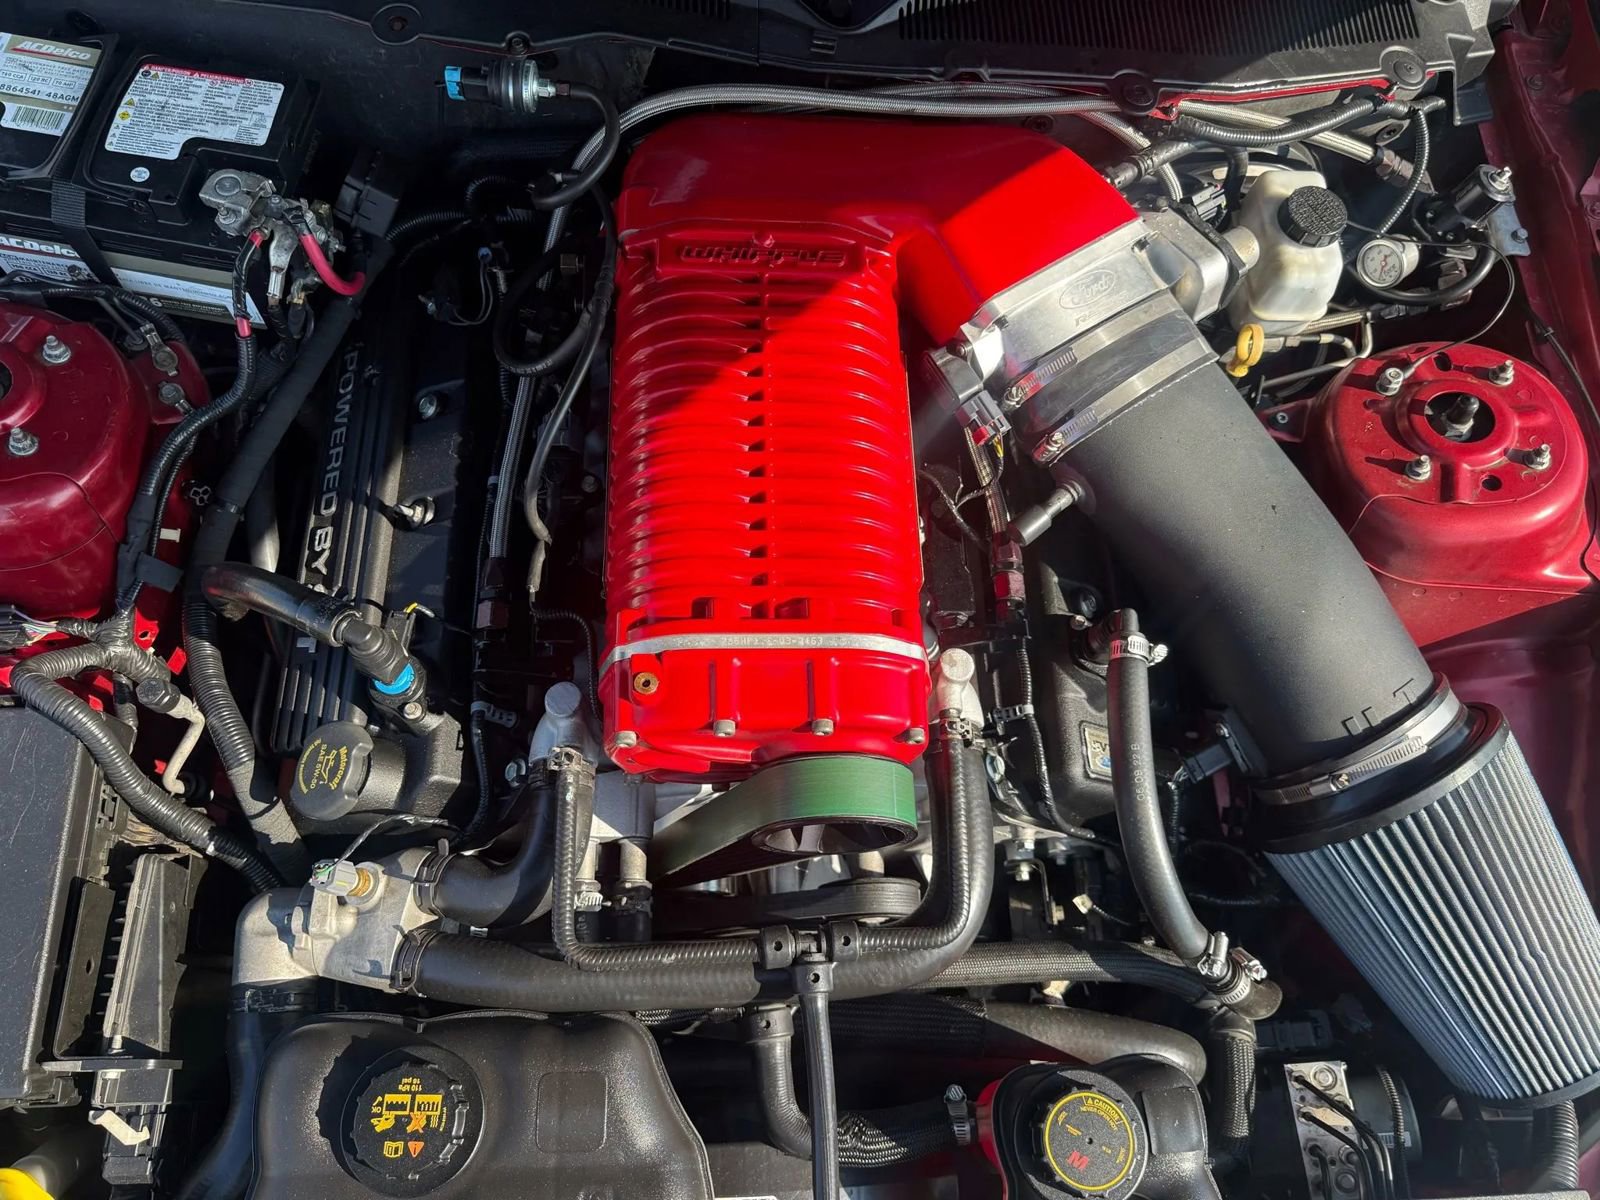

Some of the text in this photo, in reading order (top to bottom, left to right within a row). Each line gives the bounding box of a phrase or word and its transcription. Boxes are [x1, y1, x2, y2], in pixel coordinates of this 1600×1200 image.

[15, 40, 92, 61] ACDelco
[0, 236, 80, 259] ACDelc
[315, 351, 359, 517] POWERED
[311, 526, 334, 576] BY
[317, 743, 328, 762] SAE
[329, 745, 348, 791] Motorcraft
[398, 1084, 422, 1092] 110 kPa
[401, 1077, 413, 1085] psi
[1094, 1099, 1120, 1121] CAUTION
